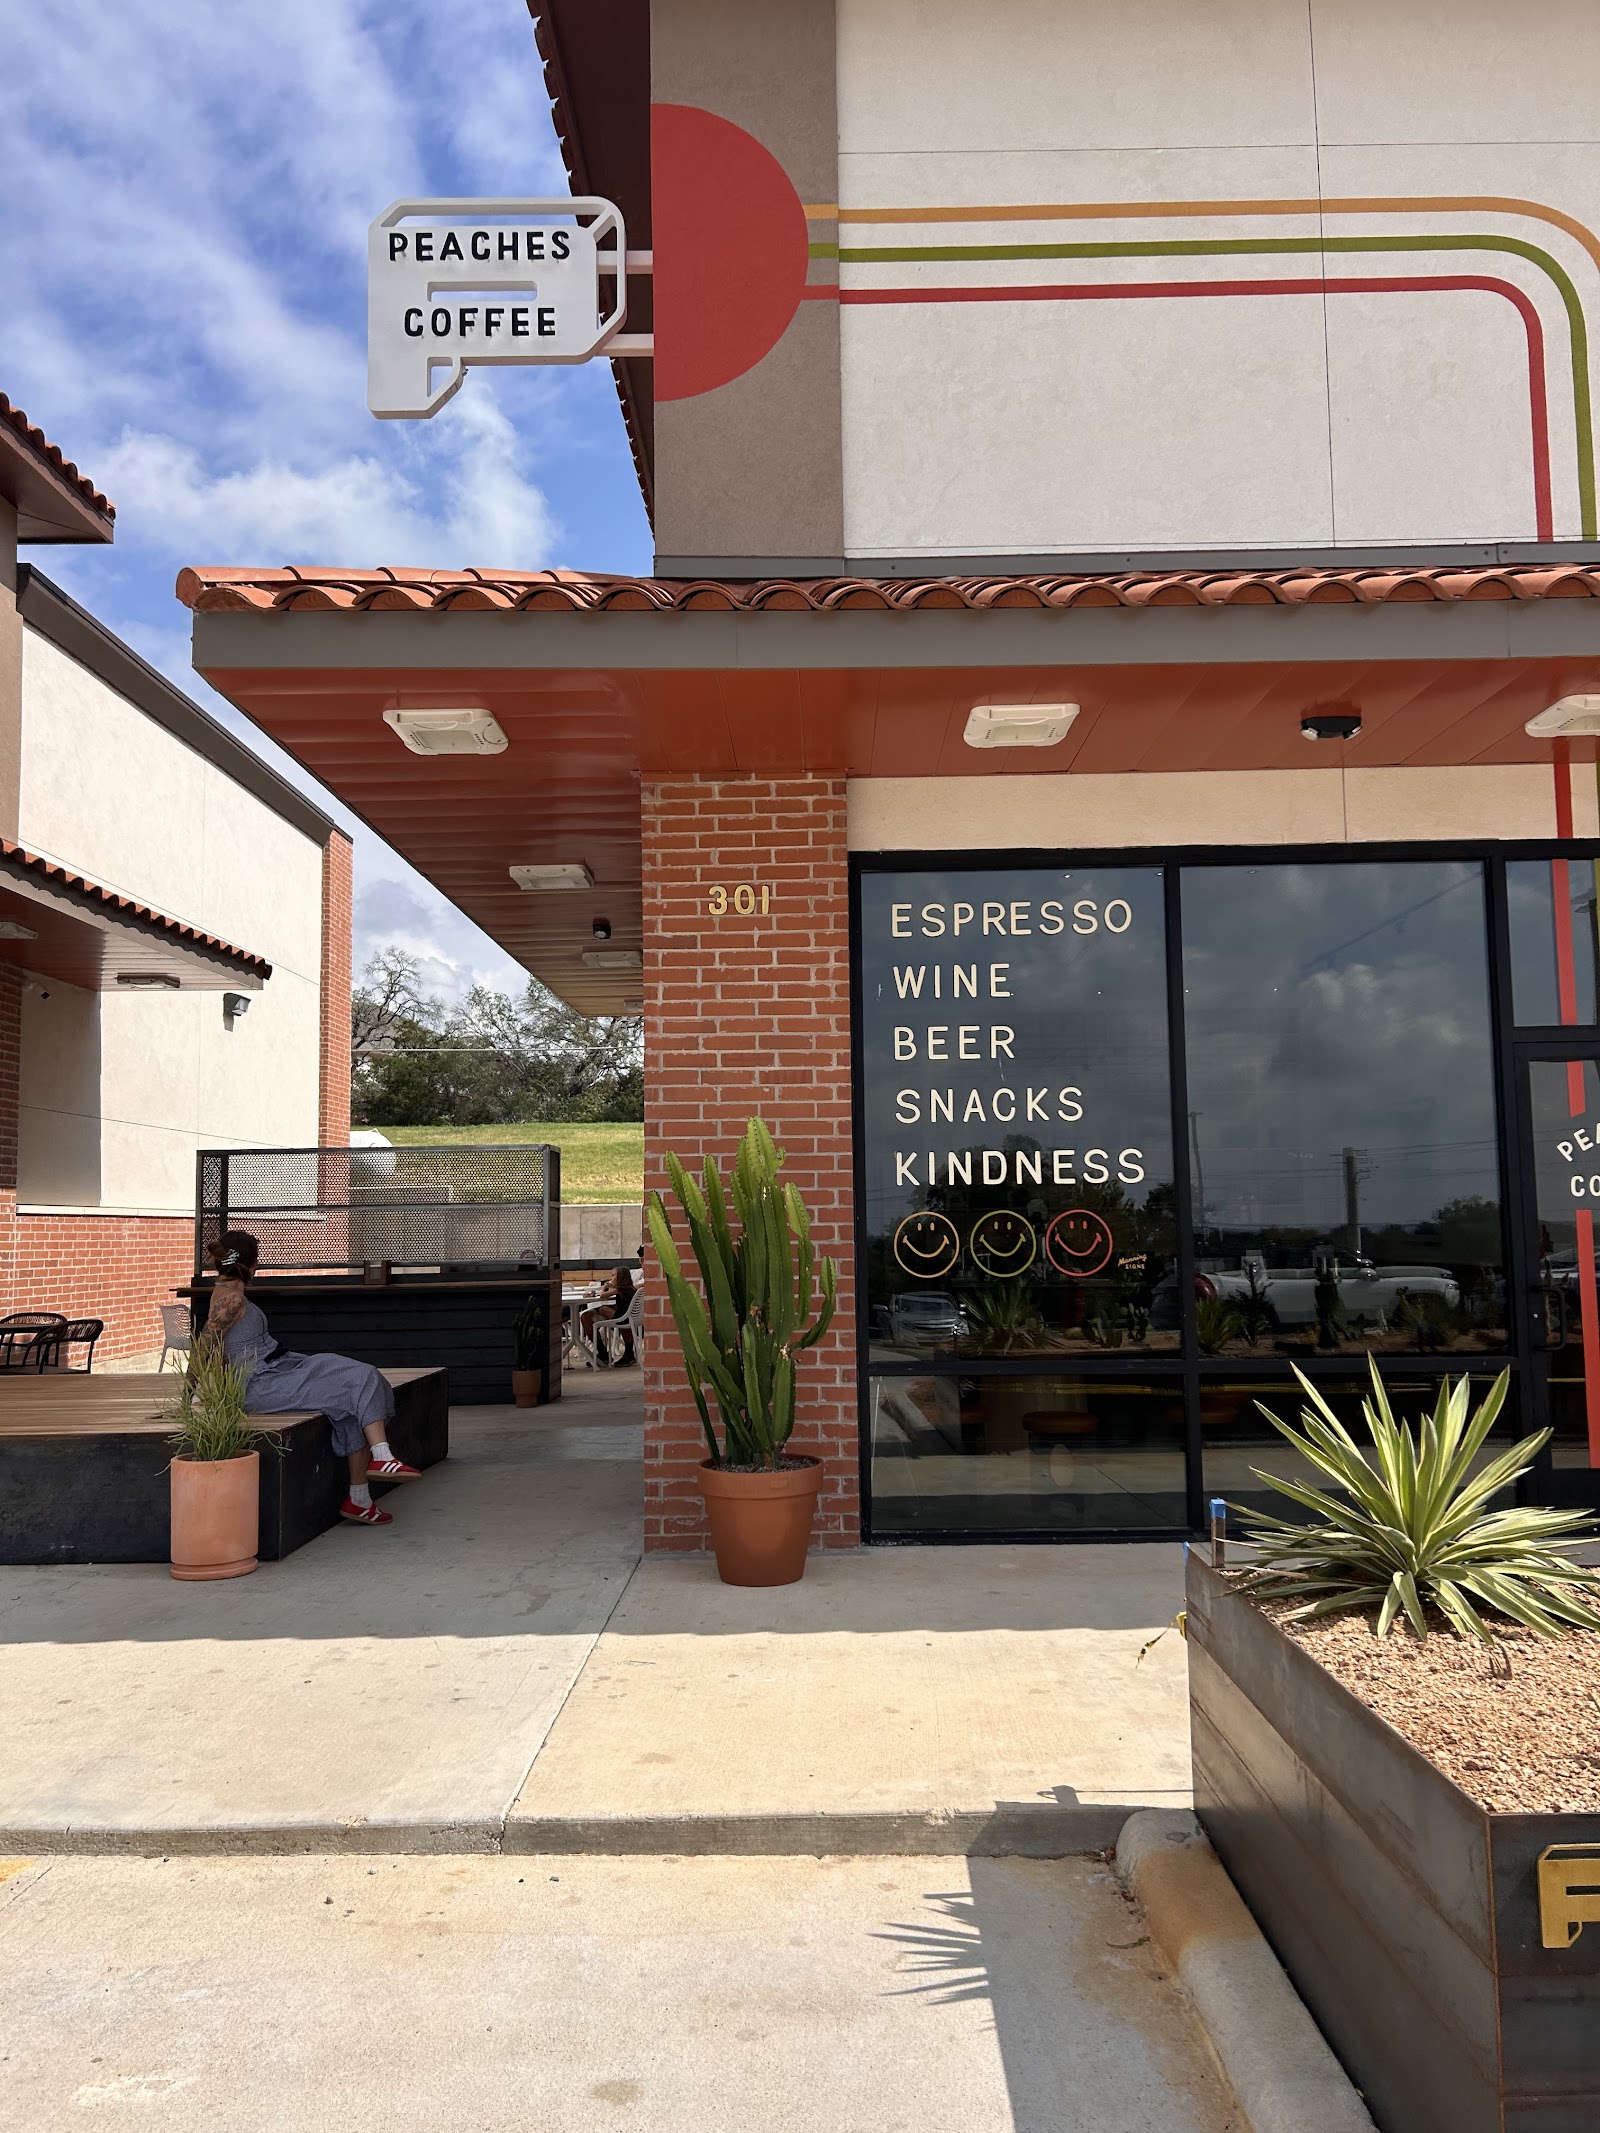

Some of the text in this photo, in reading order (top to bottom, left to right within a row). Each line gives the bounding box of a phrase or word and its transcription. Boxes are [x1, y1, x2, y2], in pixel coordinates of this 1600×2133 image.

[388, 230, 571, 262] PEACHES
[403, 307, 556, 337] COFFEE
[708, 884, 770, 915] 301
[891, 899, 1132, 938] ESPRESSO
[892, 963, 1012, 999] WINE
[894, 1025, 1016, 1061] BEER
[895, 1086, 1084, 1124] SNACKS
[1556, 1122, 1600, 1162] PE
[895, 1147, 1145, 1187] KINDNESS
